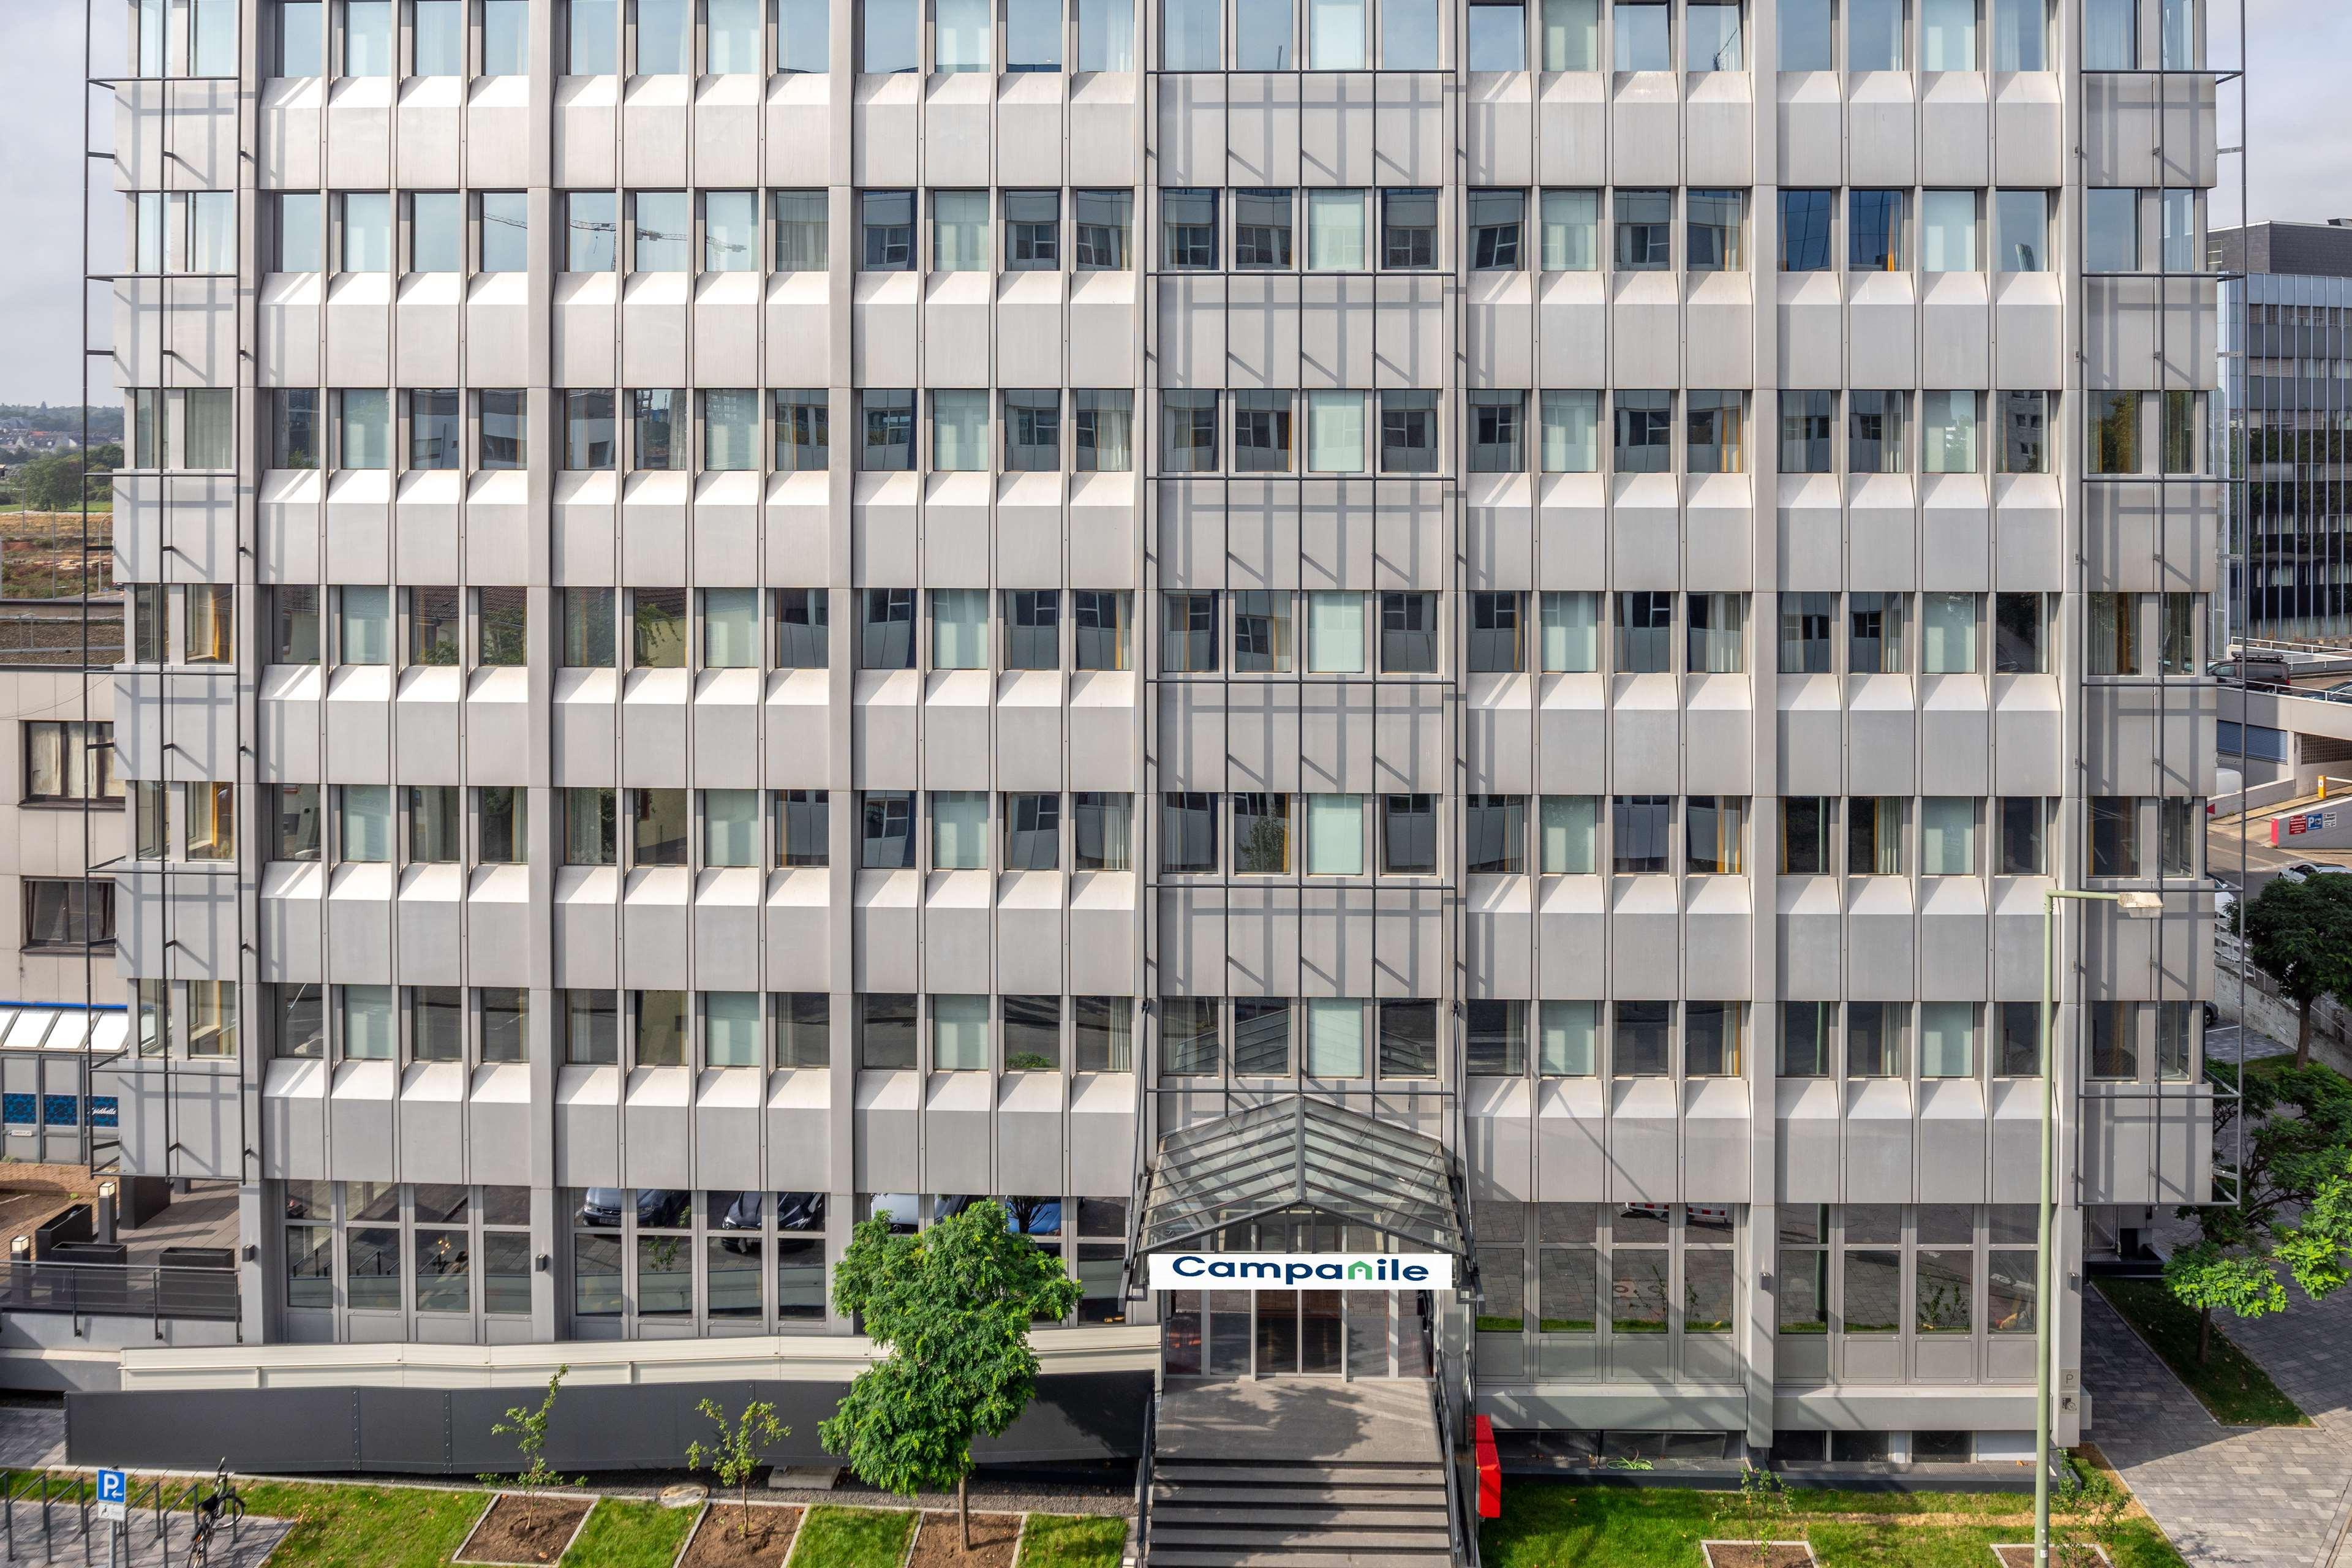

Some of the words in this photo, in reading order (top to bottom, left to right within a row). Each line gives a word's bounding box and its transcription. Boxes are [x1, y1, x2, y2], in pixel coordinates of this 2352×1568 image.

[2308, 816, 2314, 827] P
[1172, 1256, 1429, 1285] Campanile
[2066, 1374, 2073, 1384] P
[103, 1473, 119, 1498] P
